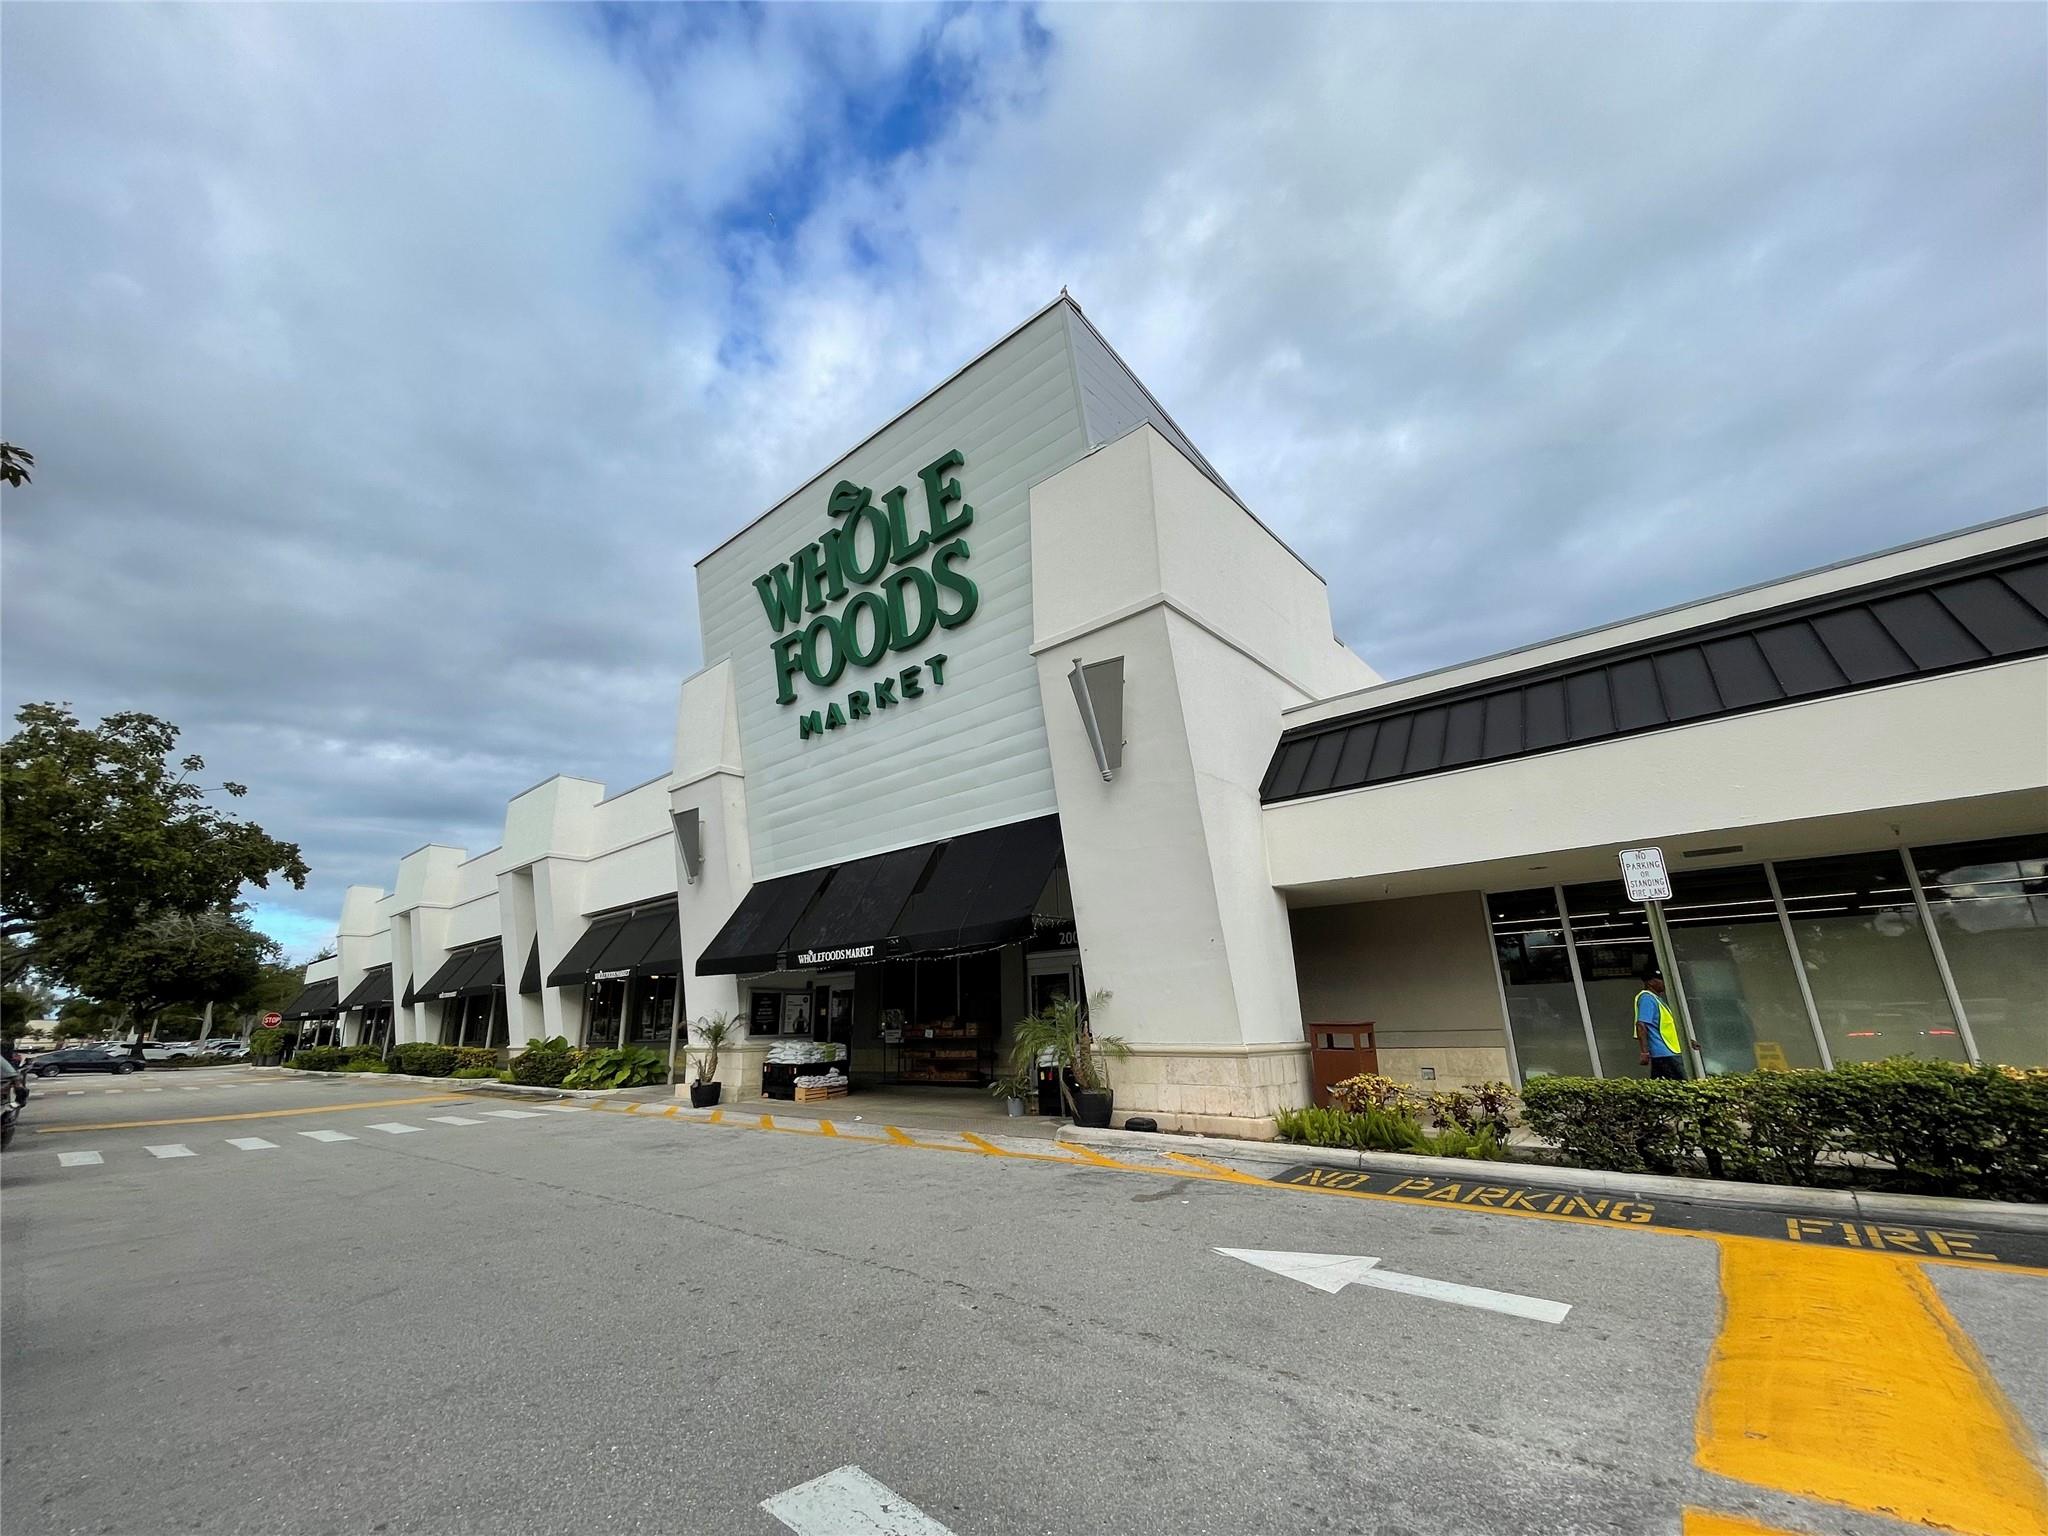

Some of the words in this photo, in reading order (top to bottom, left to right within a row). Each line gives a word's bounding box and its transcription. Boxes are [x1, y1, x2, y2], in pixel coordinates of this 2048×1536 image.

[752, 449, 974, 633] WHOLE
[770, 538, 979, 705] FOODS
[800, 654, 948, 740] MARKET
[1635, 852, 1646, 860] NO
[1626, 861, 1660, 871] PARKING
[1630, 878, 1665, 888] STANDING
[1632, 889, 1647, 898] FIRE
[1649, 887, 1667, 896] LANE
[846, 945, 874, 959] MARKET
[1291, 1168, 1370, 1190] NO
[1386, 1176, 1656, 1223] PARKING
[1786, 1218, 1998, 1261] FIRE
